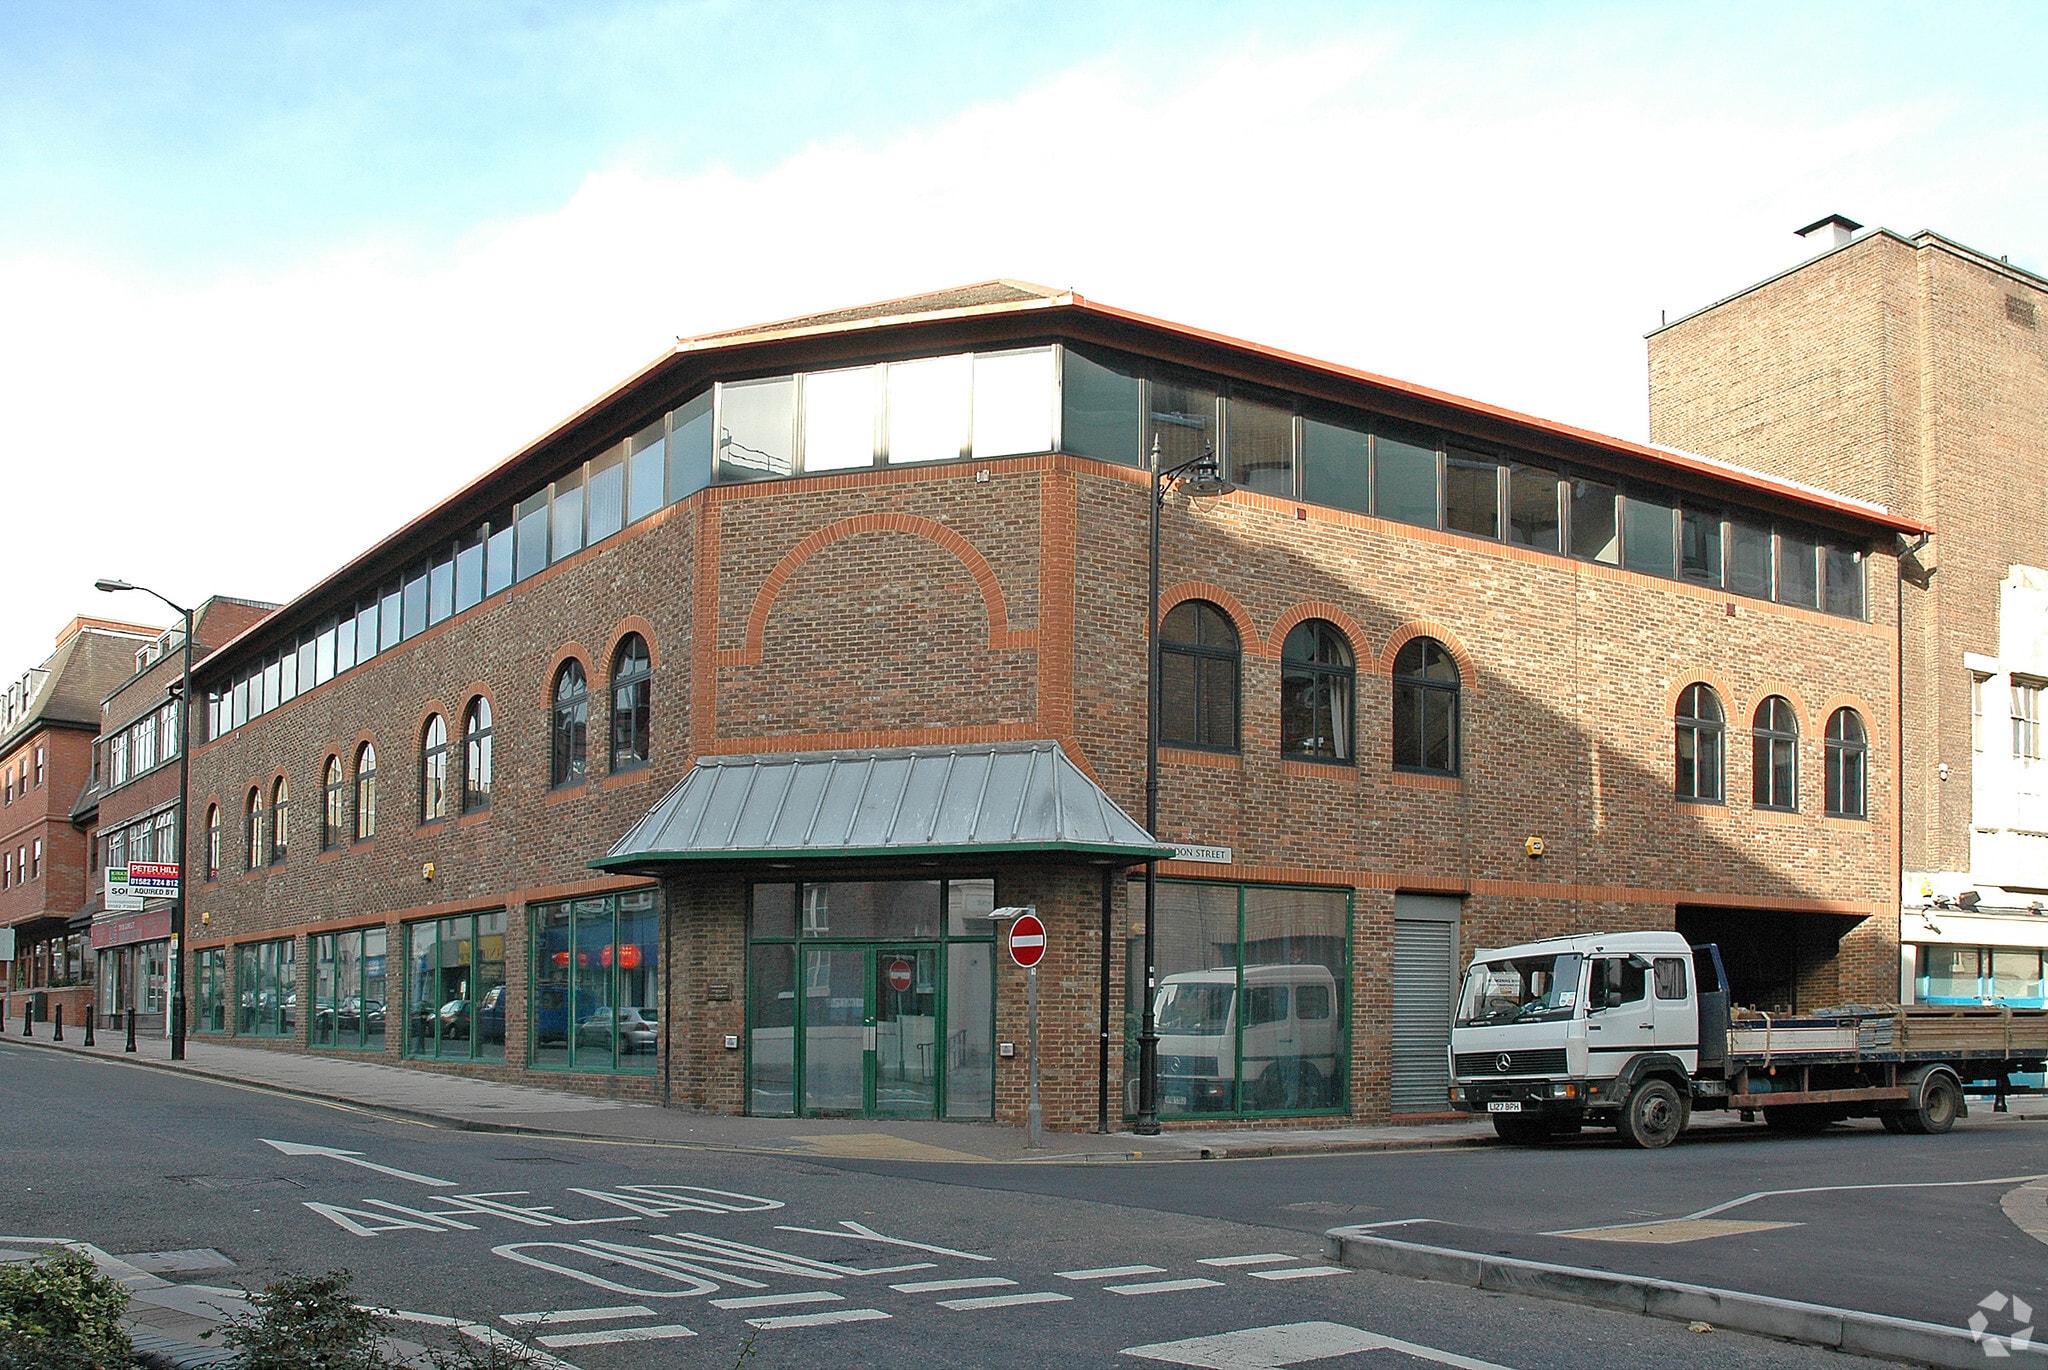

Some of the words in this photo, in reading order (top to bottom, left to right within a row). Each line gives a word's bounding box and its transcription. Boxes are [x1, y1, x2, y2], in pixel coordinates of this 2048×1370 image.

[1195, 848, 1226, 859] STREET
[131, 864, 158, 873] PETER
[159, 865, 178, 874] HILL
[130, 877, 151, 886] 01582
[166, 879, 179, 887] 812
[302, 1185, 785, 1237] AHEAD
[491, 1221, 997, 1298] ONLY
